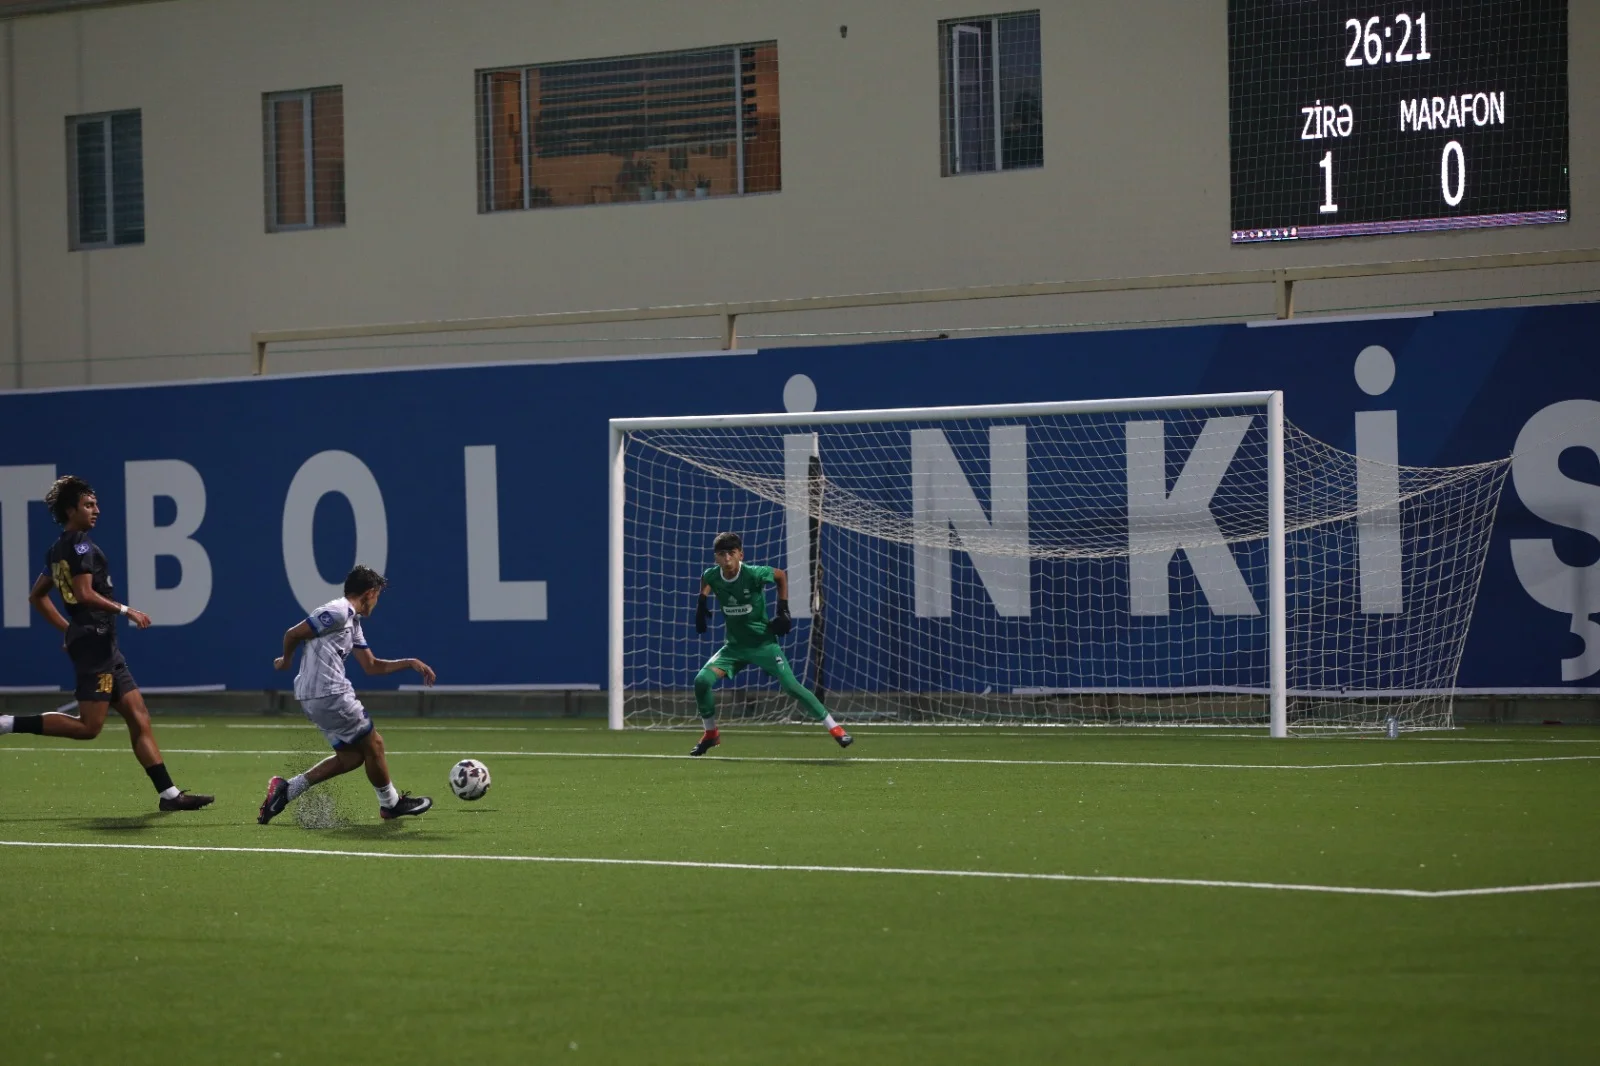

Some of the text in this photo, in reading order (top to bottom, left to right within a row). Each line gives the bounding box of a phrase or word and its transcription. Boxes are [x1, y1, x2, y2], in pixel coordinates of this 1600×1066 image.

[1345, 13, 1432, 67] 26:21
[1301, 99, 1354, 140] ZİRƏ
[1400, 91, 1505, 132] MARAFON
[1318, 150, 1339, 214] 1
[1440, 140, 1466, 207] 0
